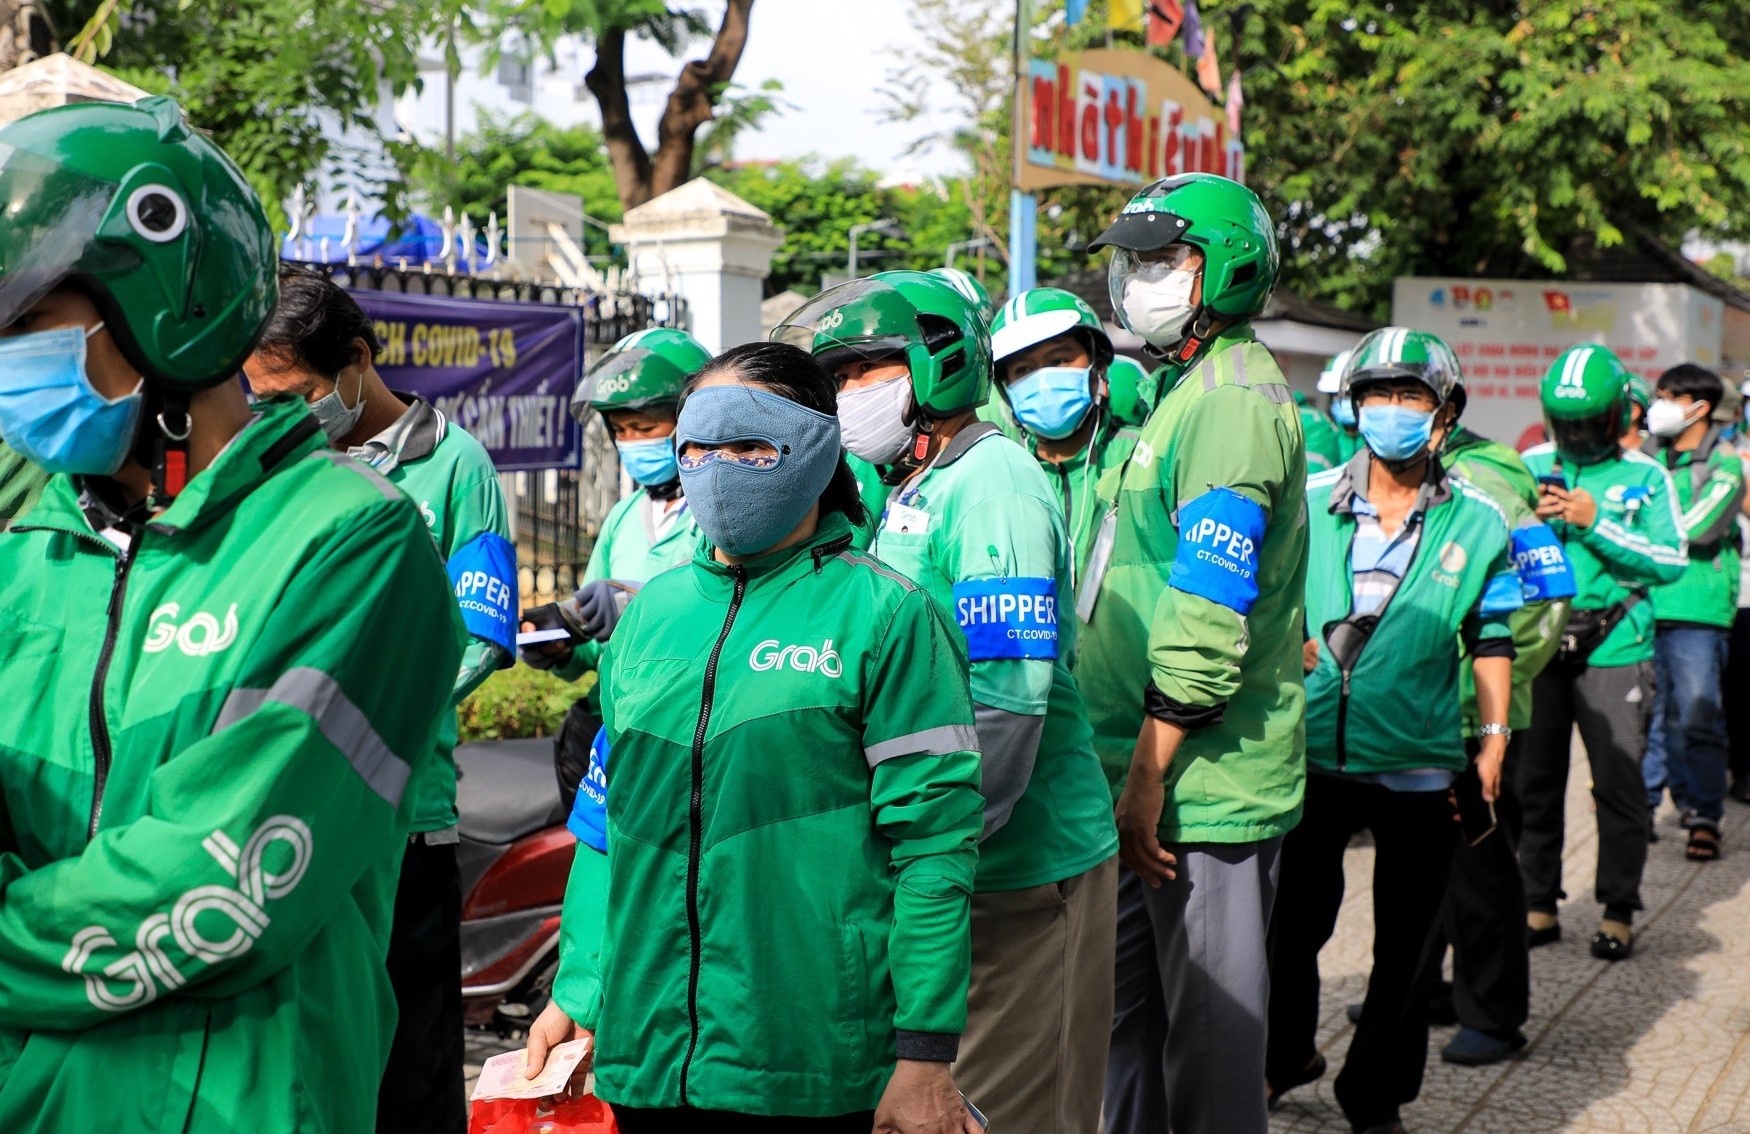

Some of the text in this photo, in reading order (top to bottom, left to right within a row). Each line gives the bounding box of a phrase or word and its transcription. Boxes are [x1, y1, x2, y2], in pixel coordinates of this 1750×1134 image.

[1033, 64, 1099, 162] nhà
[373, 320, 517, 368] CH COVID-19
[1196, 549, 1251, 579] CT.COVID-19
[1516, 545, 1565, 570] PPER
[958, 593, 1056, 627] SHIPPER
[749, 638, 843, 678] Grab
[62, 815, 313, 1012] Grab
